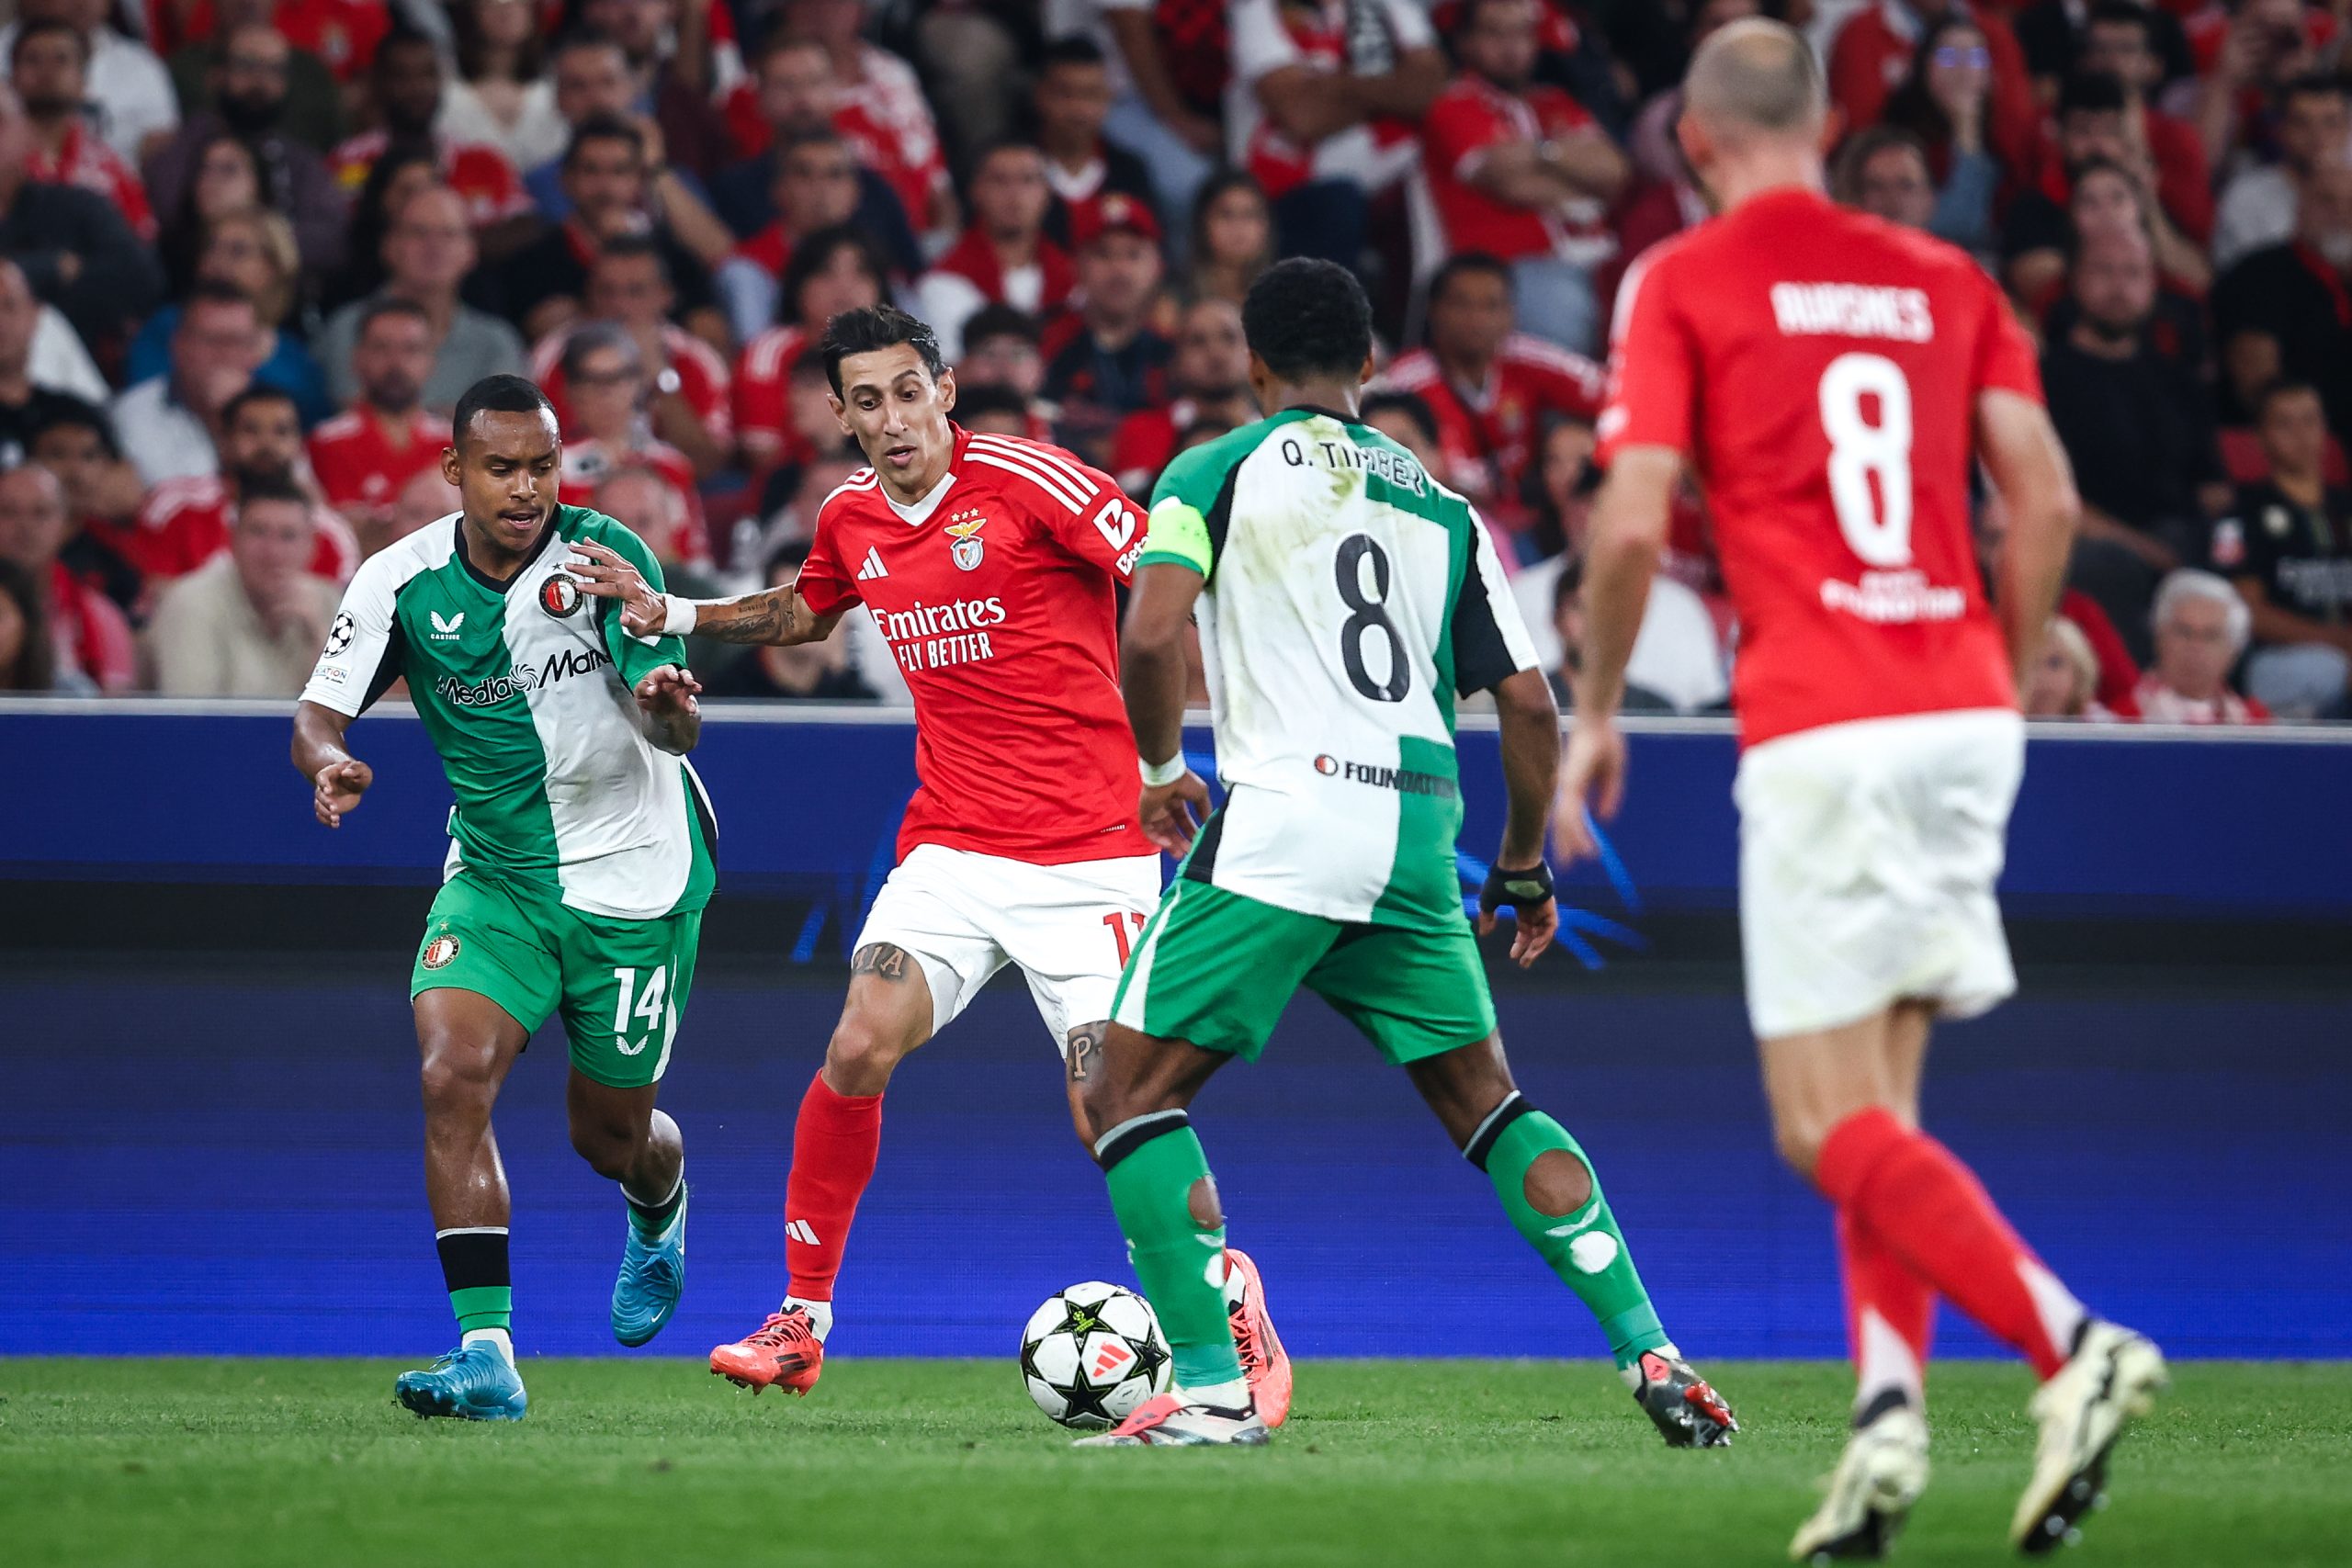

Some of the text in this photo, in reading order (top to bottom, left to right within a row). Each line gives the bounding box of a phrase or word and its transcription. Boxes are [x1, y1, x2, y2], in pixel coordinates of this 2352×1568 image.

[1281, 438, 1426, 498] Q. TIMBER
[1816, 350, 1914, 568] 8
[872, 596, 1007, 642] Emirates
[1335, 530, 1411, 704] 8
[897, 631, 995, 672] FLY BETTER
[436, 673, 514, 706] Media
[1344, 760, 1457, 800] FOUNDAT
[1102, 911, 1146, 972] 1
[613, 964, 666, 1033] 14
[1072, 1035, 1093, 1078] P
